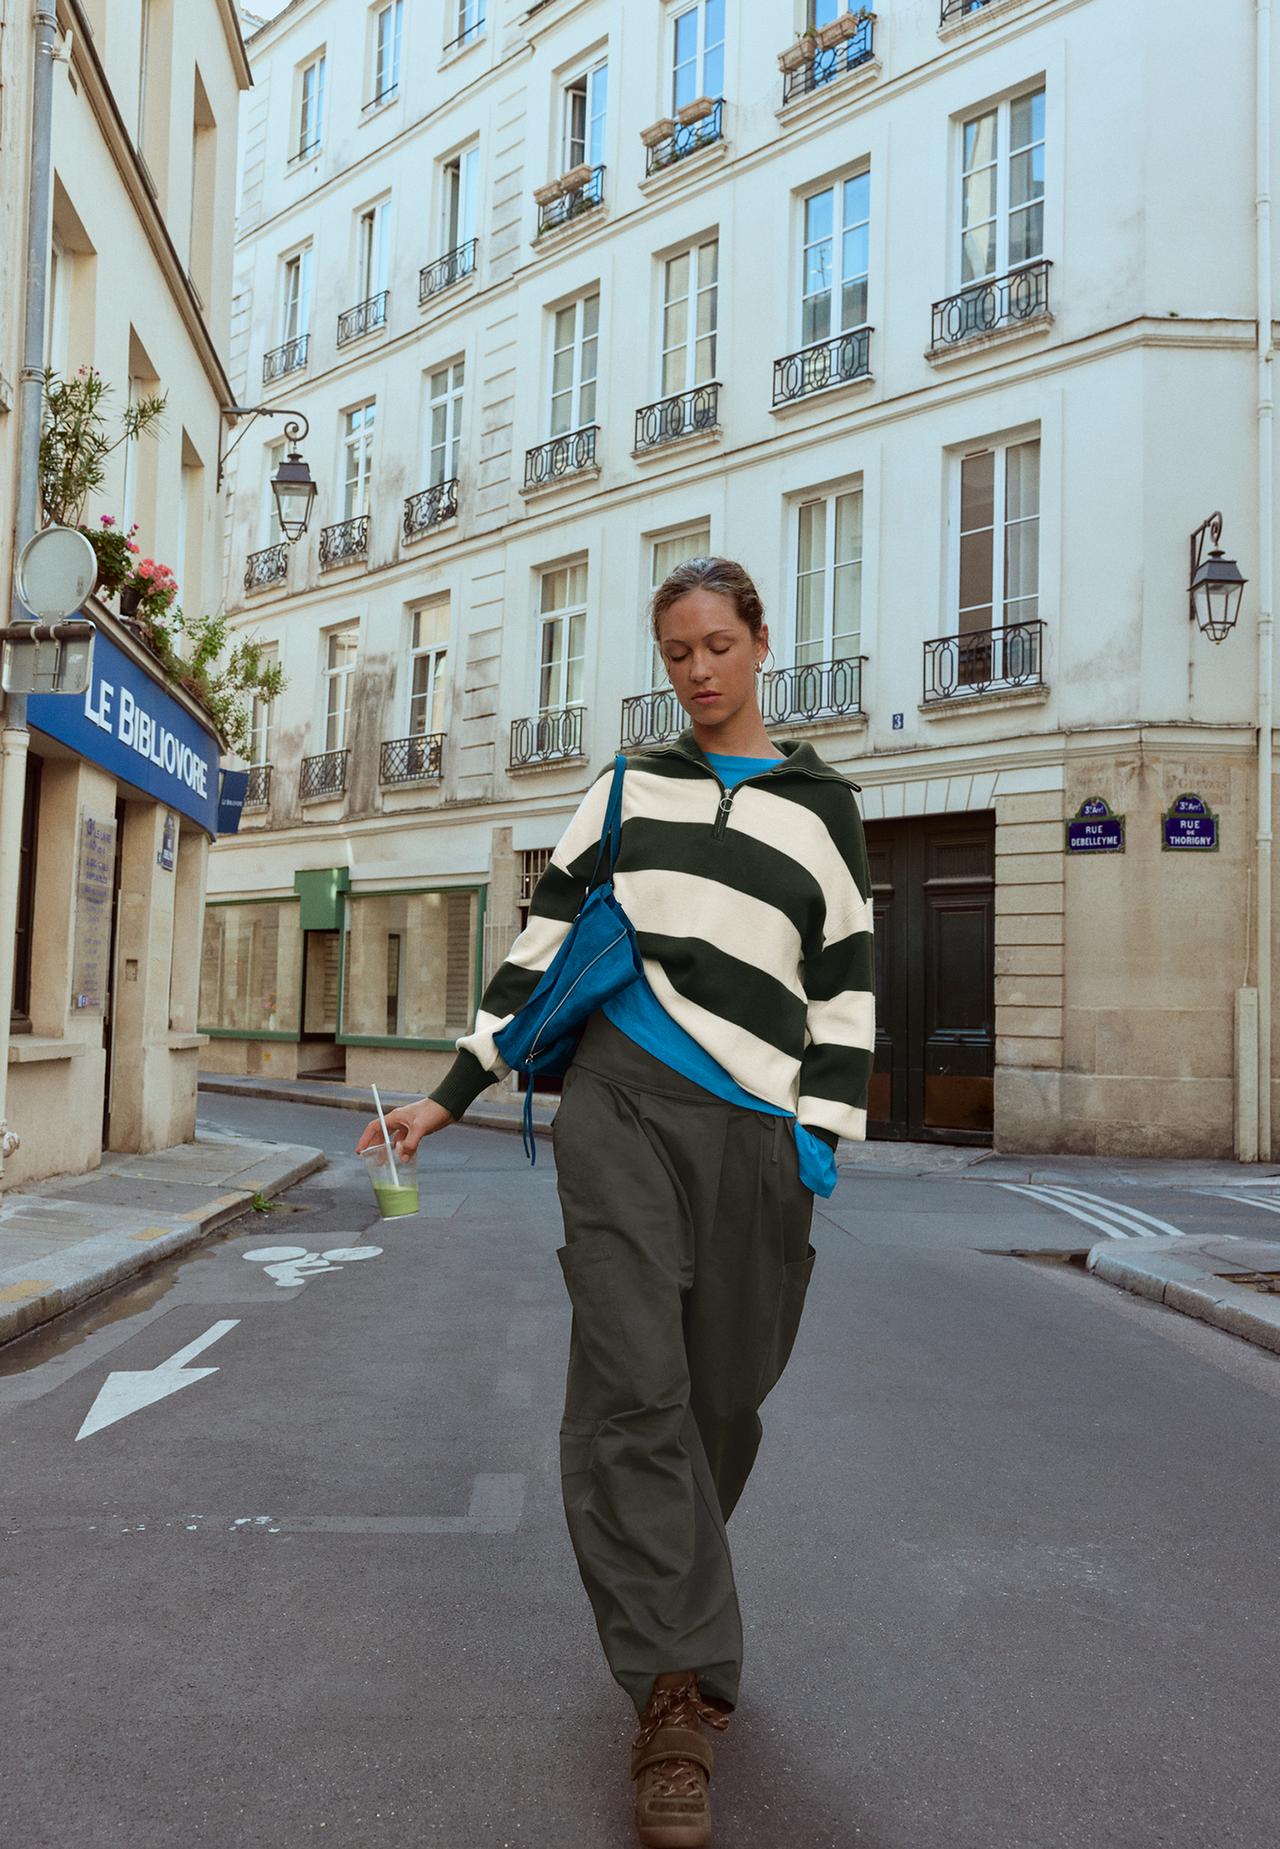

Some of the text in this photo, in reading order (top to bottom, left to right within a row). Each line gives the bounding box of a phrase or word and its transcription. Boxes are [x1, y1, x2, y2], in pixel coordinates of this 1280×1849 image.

[894, 715, 901, 729] 3
[84, 661, 208, 800] LE BIBLIOVORE
[1180, 820, 1200, 829] RUE
[1085, 825, 1103, 834] RUE
[1071, 836, 1118, 846] DEBELLEYME
[1169, 836, 1211, 845] THORIGNY
